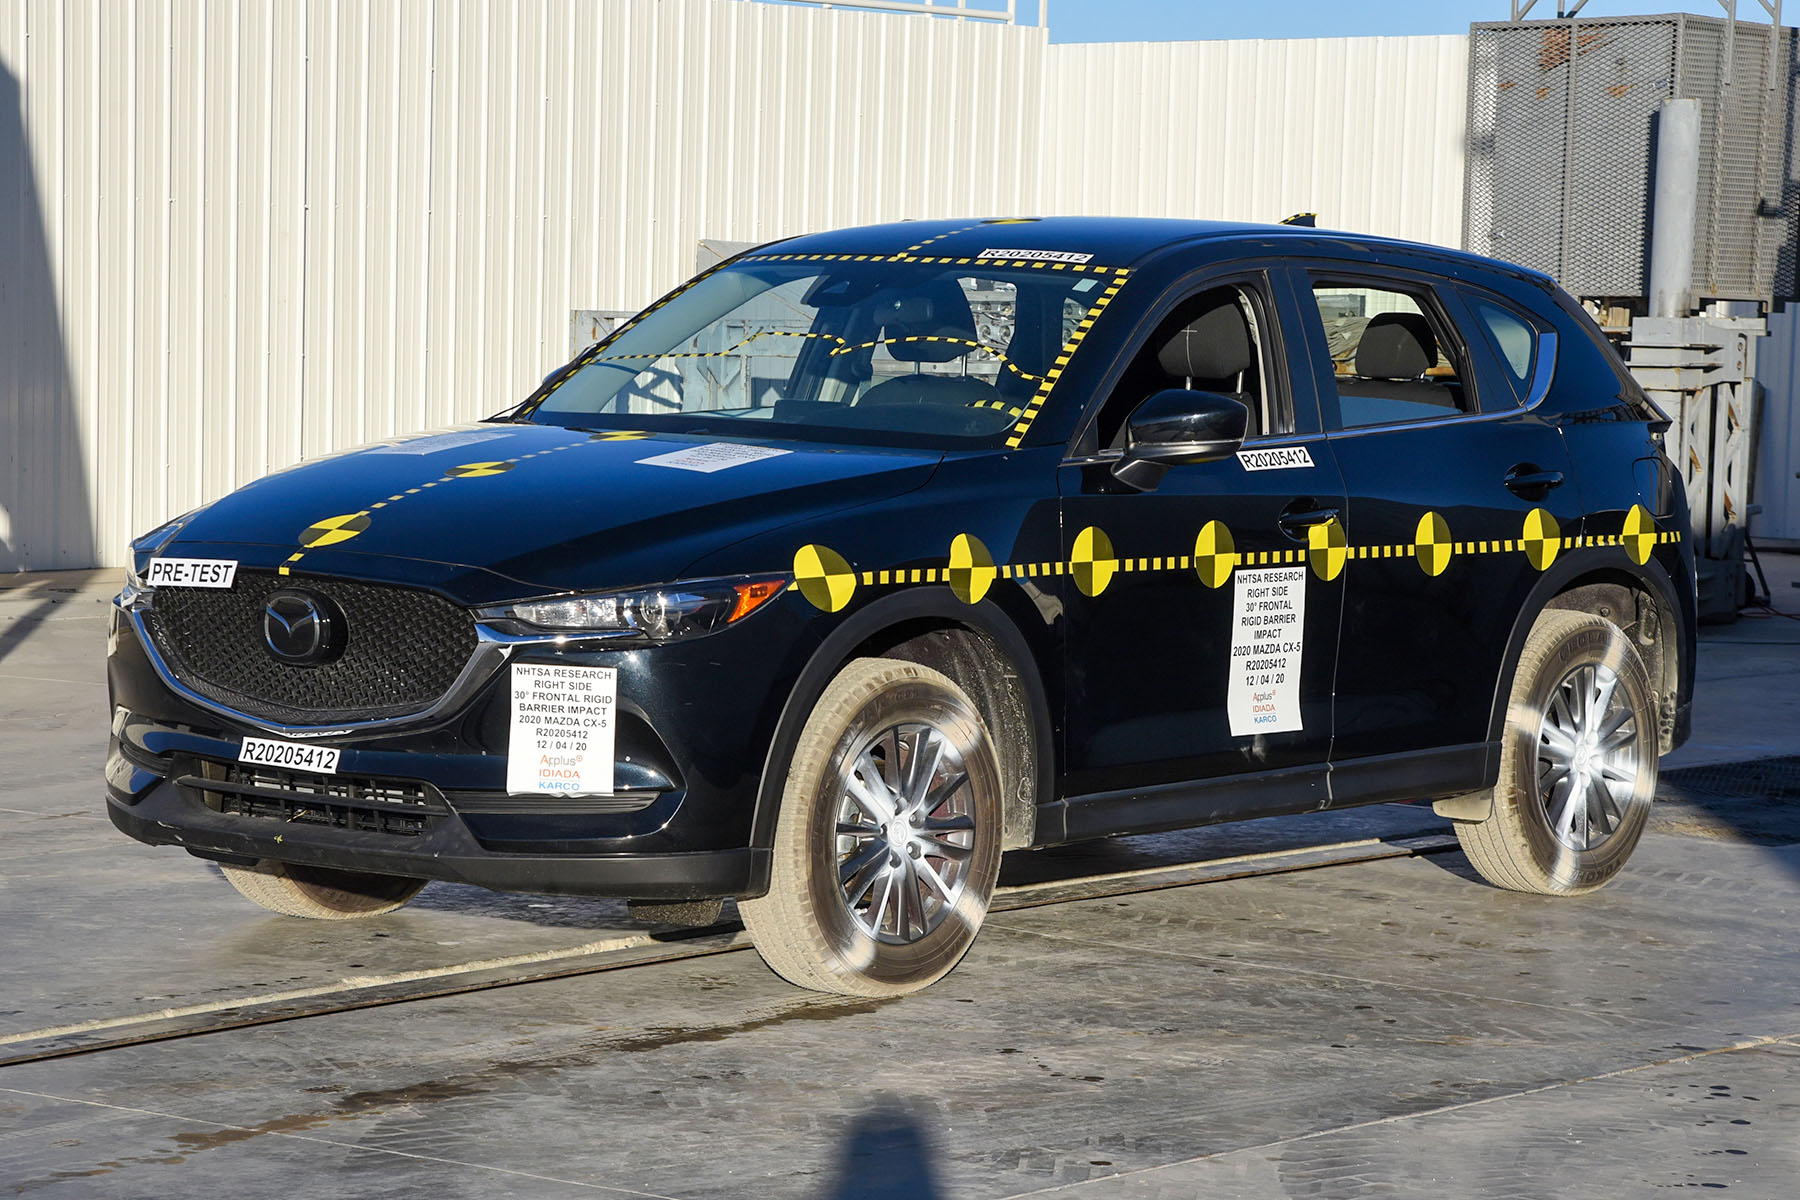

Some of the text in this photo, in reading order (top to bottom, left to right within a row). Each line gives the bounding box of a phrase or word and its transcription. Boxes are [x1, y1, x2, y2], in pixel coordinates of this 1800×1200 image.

[984, 251, 1087, 261] R20205412
[1241, 449, 1310, 468] R20205412
[152, 563, 233, 583] PRE-TEST
[1237, 571, 1304, 584] NHTSA RESEARCH
[1247, 586, 1288, 598] RIGHT SIDE
[1246, 600, 1293, 612] 30° FRONTAL
[1241, 614, 1296, 626] RIGID BARRIER
[1254, 628, 1282, 640] IMPACT
[1233, 642, 1301, 656] 2020 MAZDA CX-5
[1246, 658, 1286, 671] R20205412
[516, 667, 612, 679] NHTSA RESEARCH
[534, 680, 592, 691] RIGHT SIDE
[1246, 676, 1254, 686] 12
[1261, 674, 1269, 685] 04
[1276, 673, 1284, 684] 20
[514, 691, 612, 704] 30° FRONTAL RIGID
[519, 703, 607, 715] BARRIER IMPACT
[1252, 704, 1275, 713] IDIADA
[519, 715, 607, 727] 2020 MAZDA CX-5
[1254, 715, 1277, 724] KARCO
[536, 728, 588, 739] R20205412
[537, 740, 547, 749] 12
[556, 741, 567, 749] 04
[576, 743, 587, 751] 20
[243, 742, 335, 769] R20205412
[539, 769, 580, 779] IDIADA
[539, 781, 580, 791] KARCO
